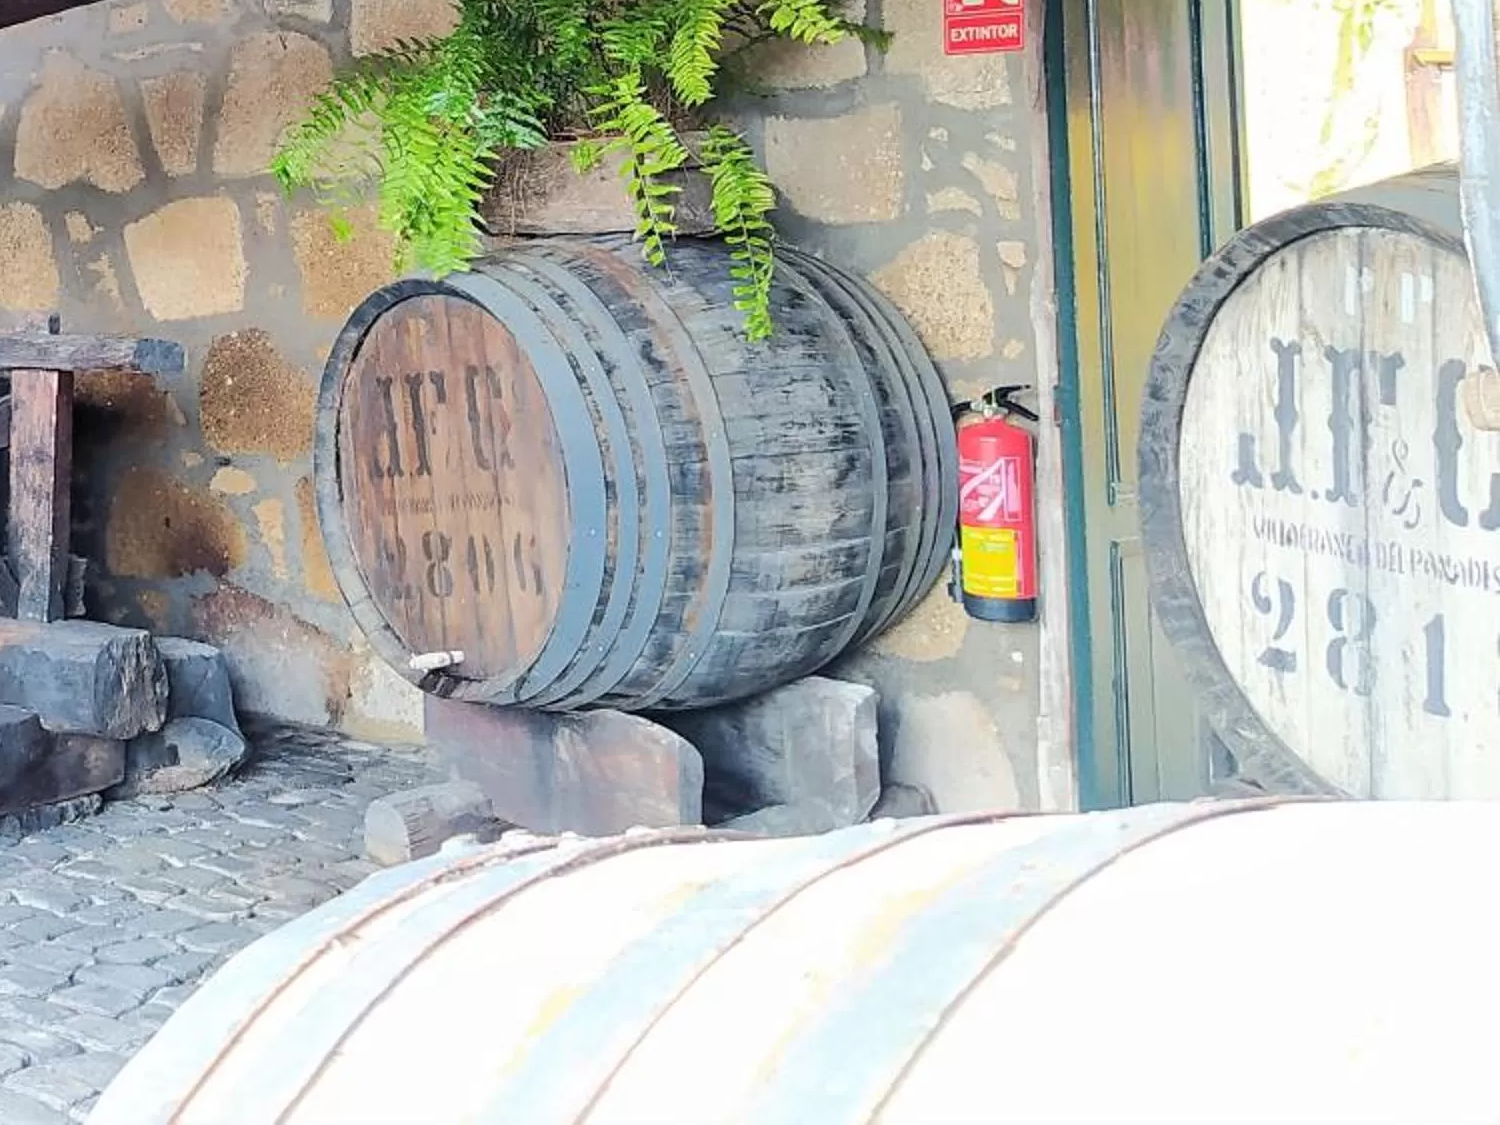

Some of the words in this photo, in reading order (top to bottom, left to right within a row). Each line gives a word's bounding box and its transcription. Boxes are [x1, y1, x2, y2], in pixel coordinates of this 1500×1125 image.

[950, 23, 1019, 43] EXTINTOR
[1375, 540, 1405, 574] DEL
[1252, 572, 1500, 718] 281
